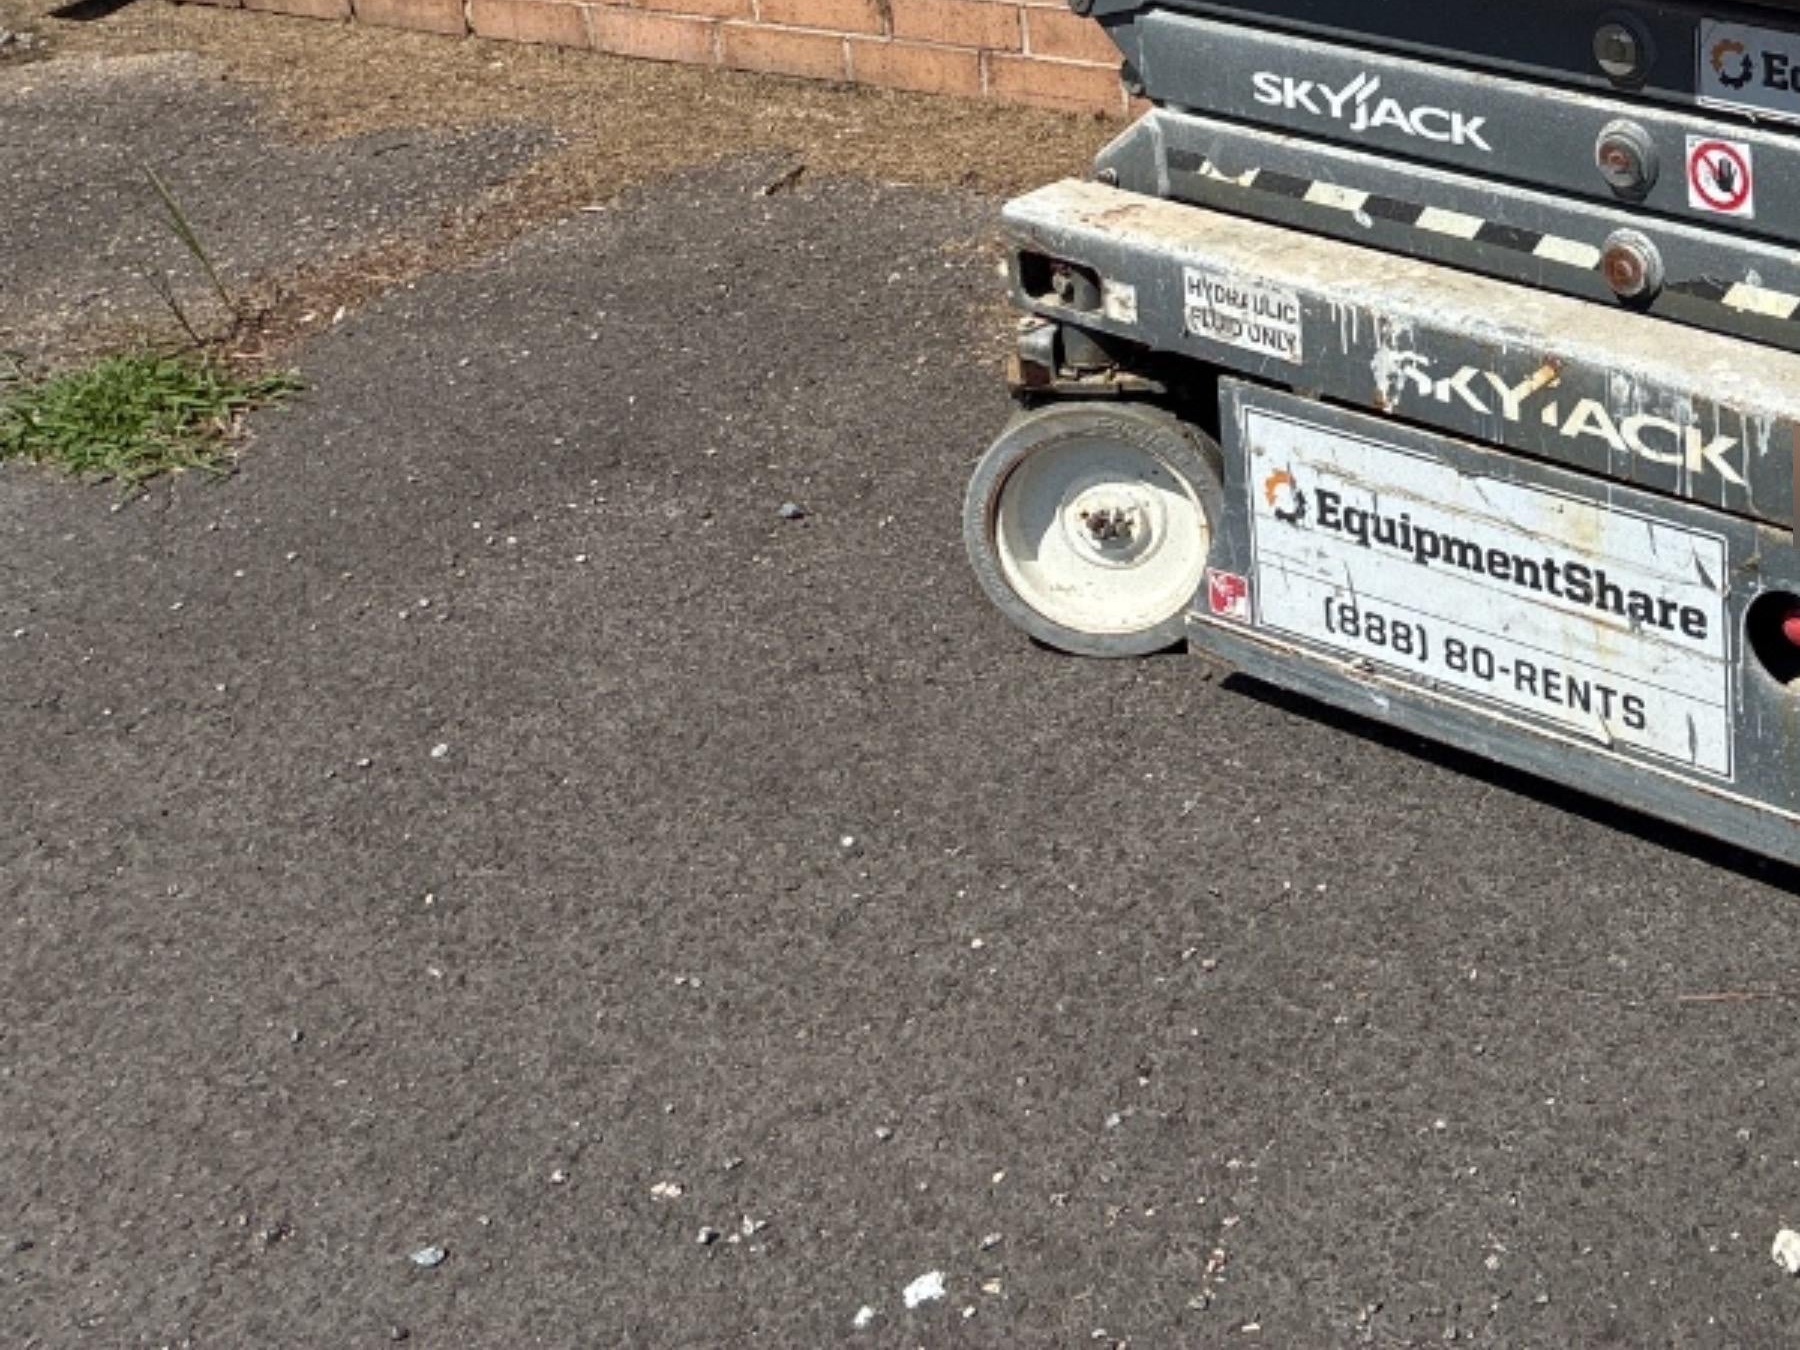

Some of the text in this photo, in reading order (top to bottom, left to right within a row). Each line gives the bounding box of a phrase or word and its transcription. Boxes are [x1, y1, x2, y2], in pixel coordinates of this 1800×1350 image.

[1252, 71, 1492, 151] SKYJACK
[1247, 323, 1297, 356] ONLY
[1314, 488, 1709, 639] EquipmentShare
[1324, 595, 1646, 731] (888) 80-RENTS
